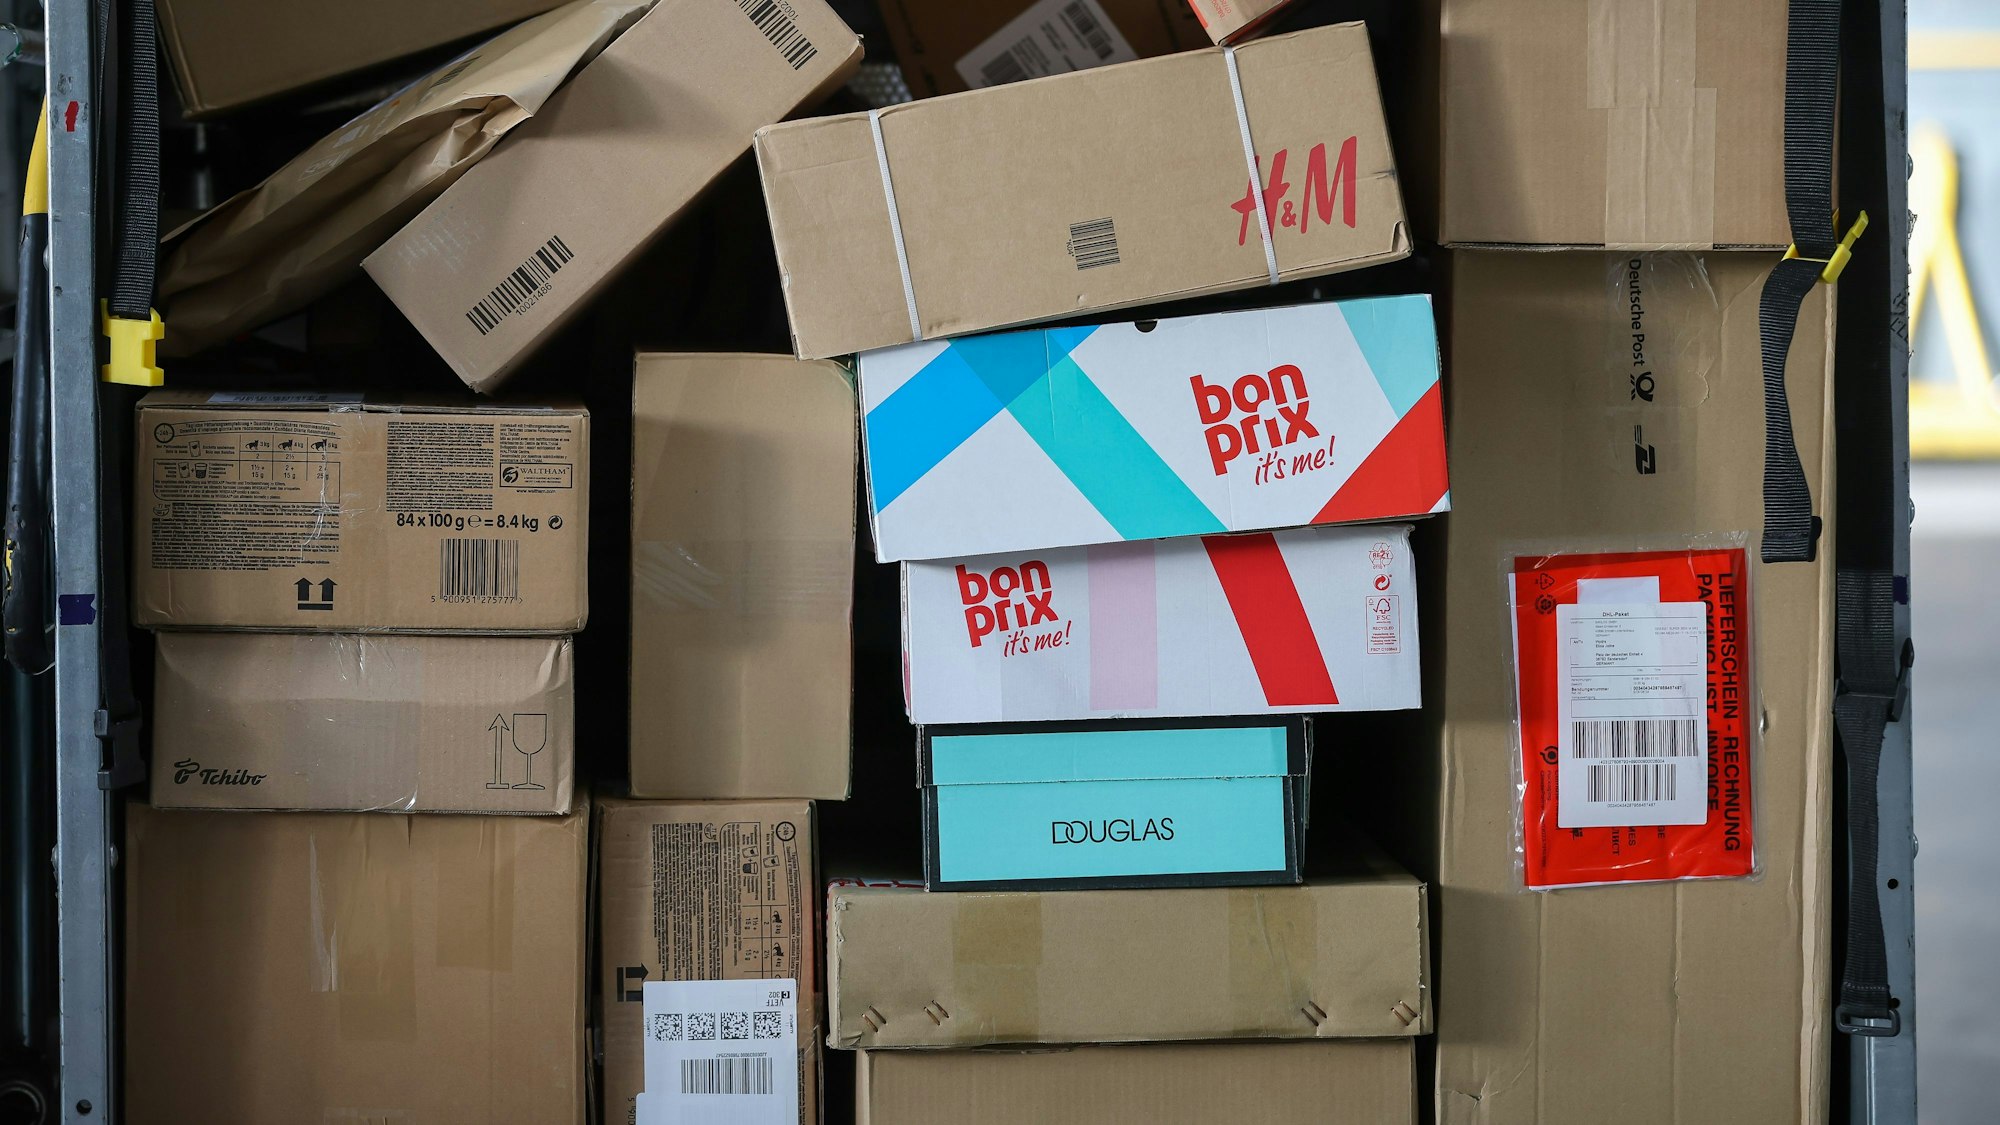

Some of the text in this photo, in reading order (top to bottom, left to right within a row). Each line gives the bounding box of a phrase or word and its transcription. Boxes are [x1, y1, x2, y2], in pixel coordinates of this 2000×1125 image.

[1231, 136, 1357, 246] H&M
[515, 282, 553, 316] 10021486
[1629, 259, 1646, 367] Deutsche Post
[1189, 364, 1309, 424] bon
[1203, 400, 1320, 476] prix
[519, 467, 567, 475] WALTHAM
[1255, 435, 1336, 486] it's me!
[396, 512, 414, 527] 84
[417, 516, 426, 527] x
[428, 513, 453, 527] 100
[455, 516, 465, 531] g
[496, 514, 519, 528] 8.4
[521, 514, 539, 532] kg
[430, 595, 436, 603] 5
[481, 596, 515, 604] 275777
[954, 560, 1052, 605] bon
[964, 590, 1059, 648] prix
[1003, 620, 1072, 658] it's me!
[1719, 572, 1738, 719] LIEFERSCHEIN
[199, 768, 267, 786] Tchibo
[1723, 736, 1741, 852] RECHNUNG
[1052, 817, 1175, 845] DOUGLAS
[765, 998, 784, 1007] VETF
[768, 991, 781, 999] 302
